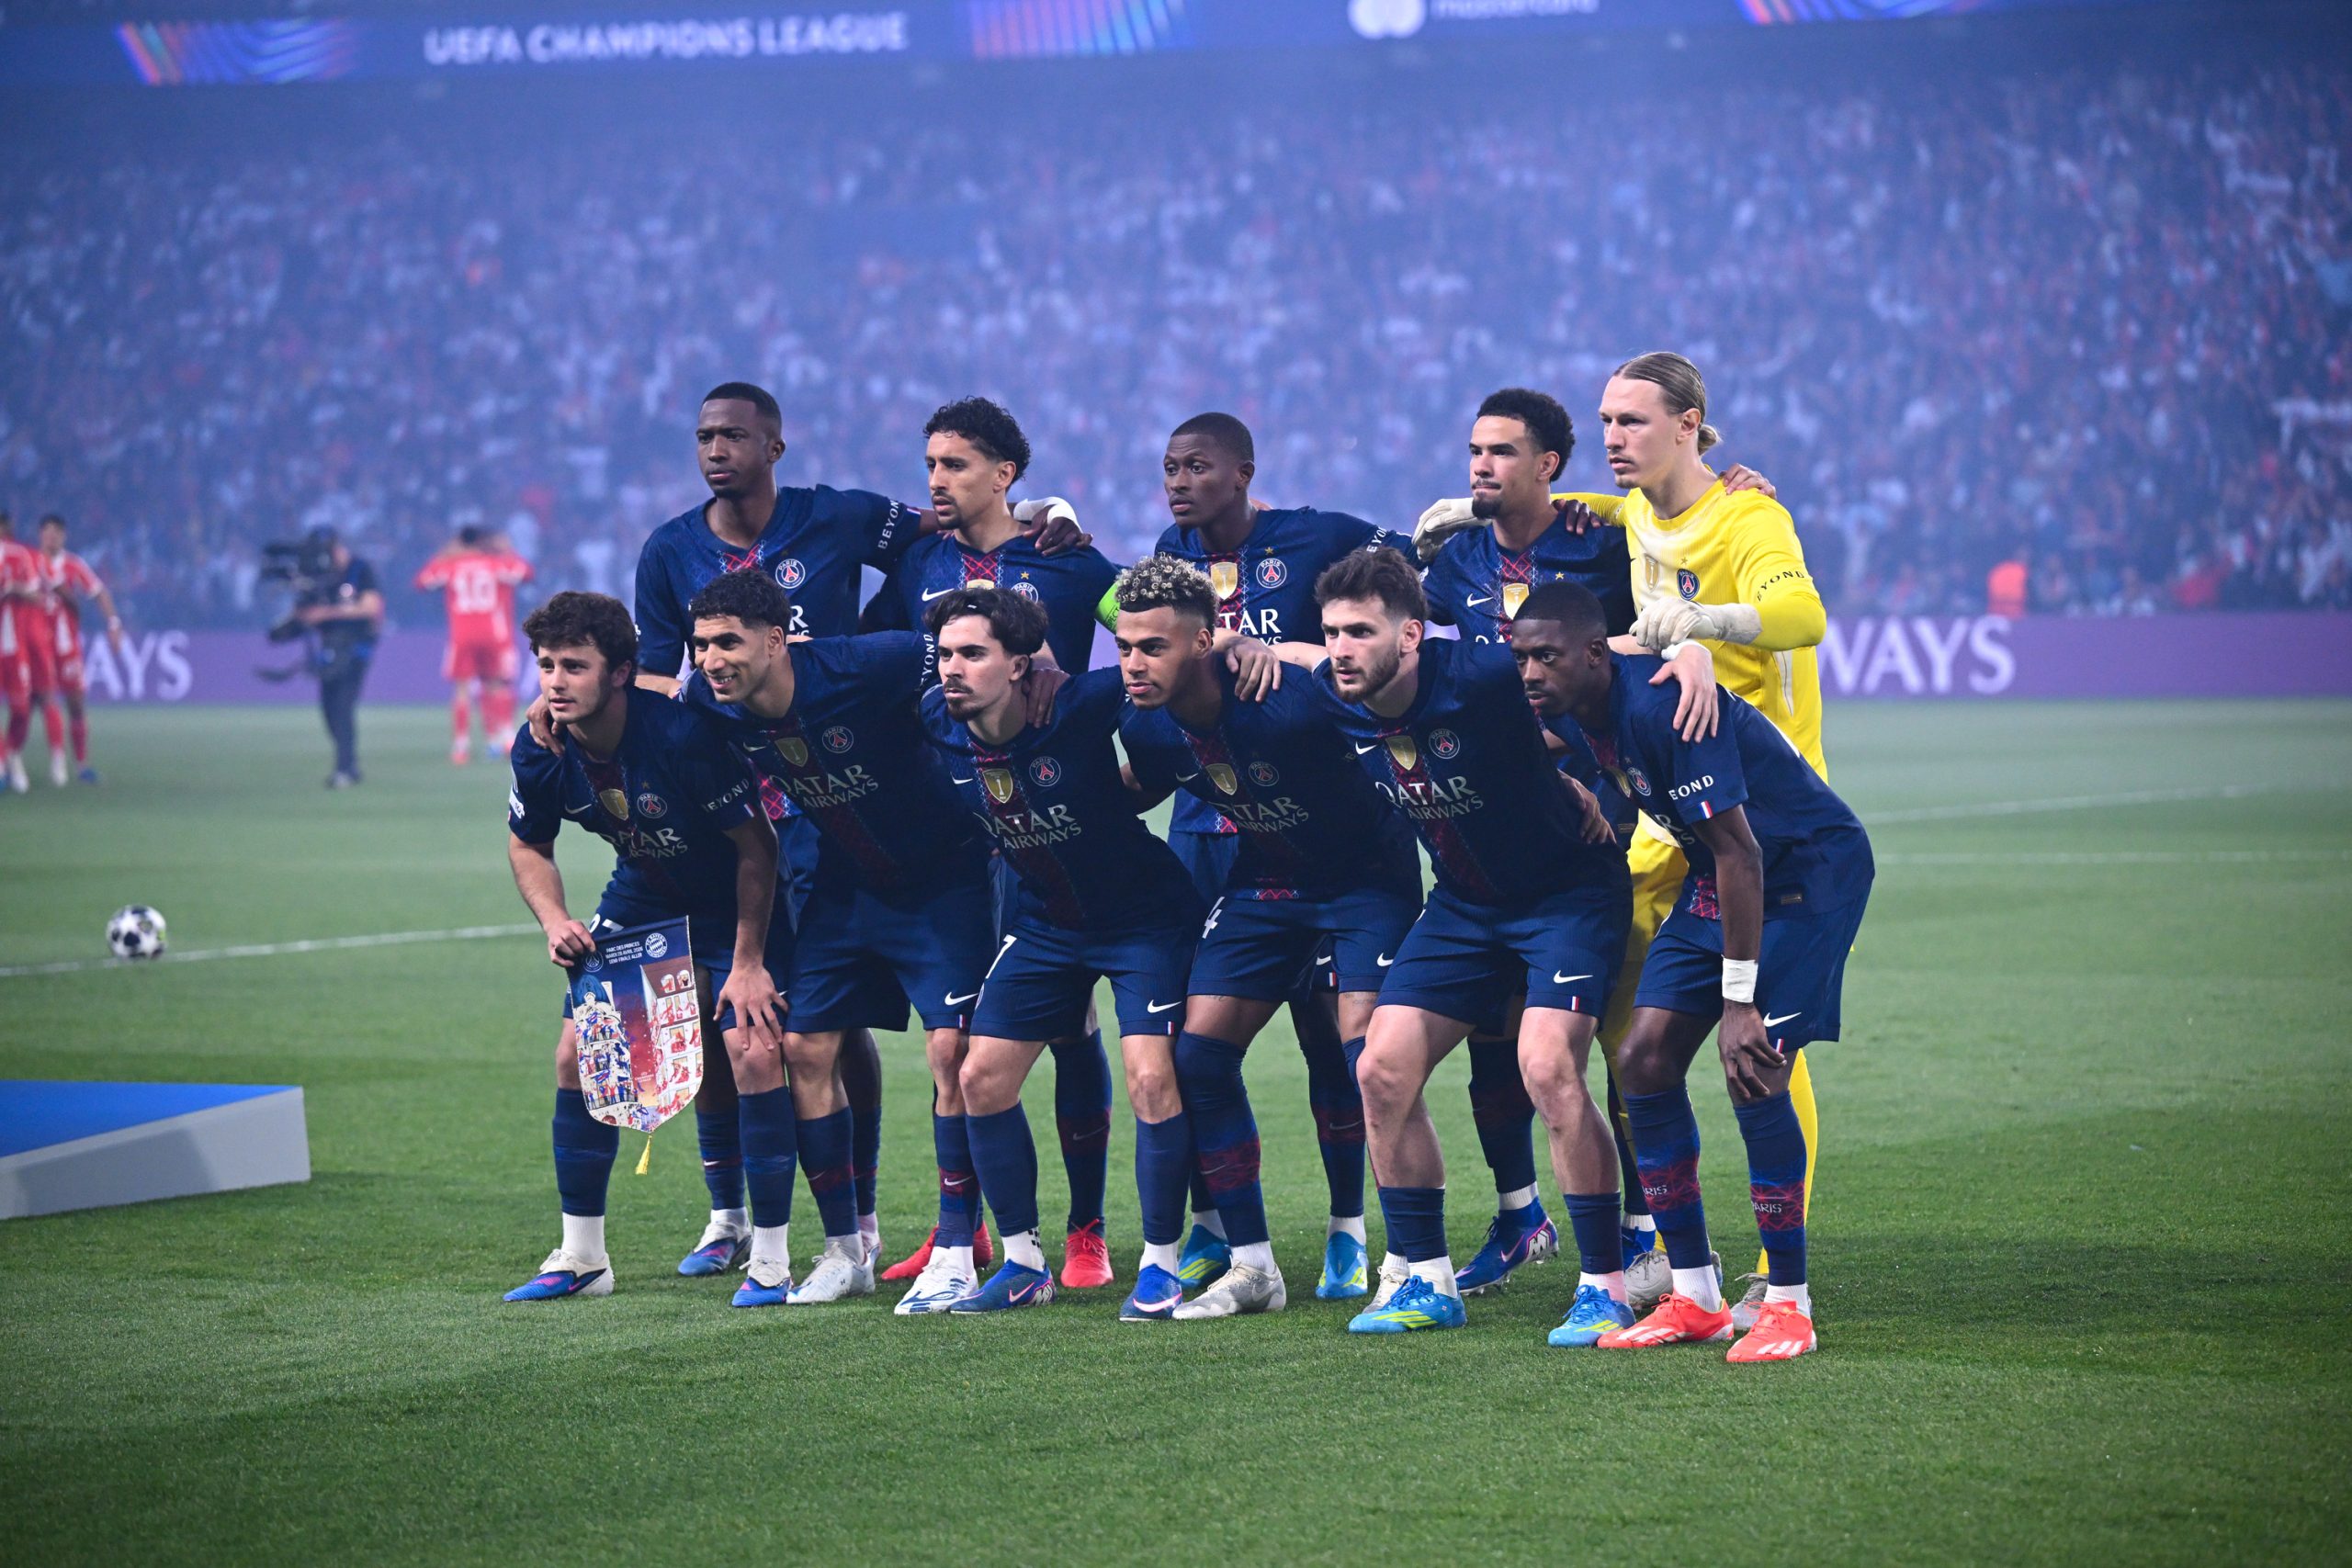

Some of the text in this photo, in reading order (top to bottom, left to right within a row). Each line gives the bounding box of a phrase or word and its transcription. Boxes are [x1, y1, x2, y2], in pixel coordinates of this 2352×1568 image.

[424, 12, 908, 64] UEFA CHAMPIONS LEAGUE
[1366, 526, 1386, 553] EYO
[79, 628, 193, 701] AYS
[803, 778, 878, 808] AIRWAYS
[1408, 795, 1484, 819] AIRWAYS
[1003, 823, 1082, 849] AIRWAYS
